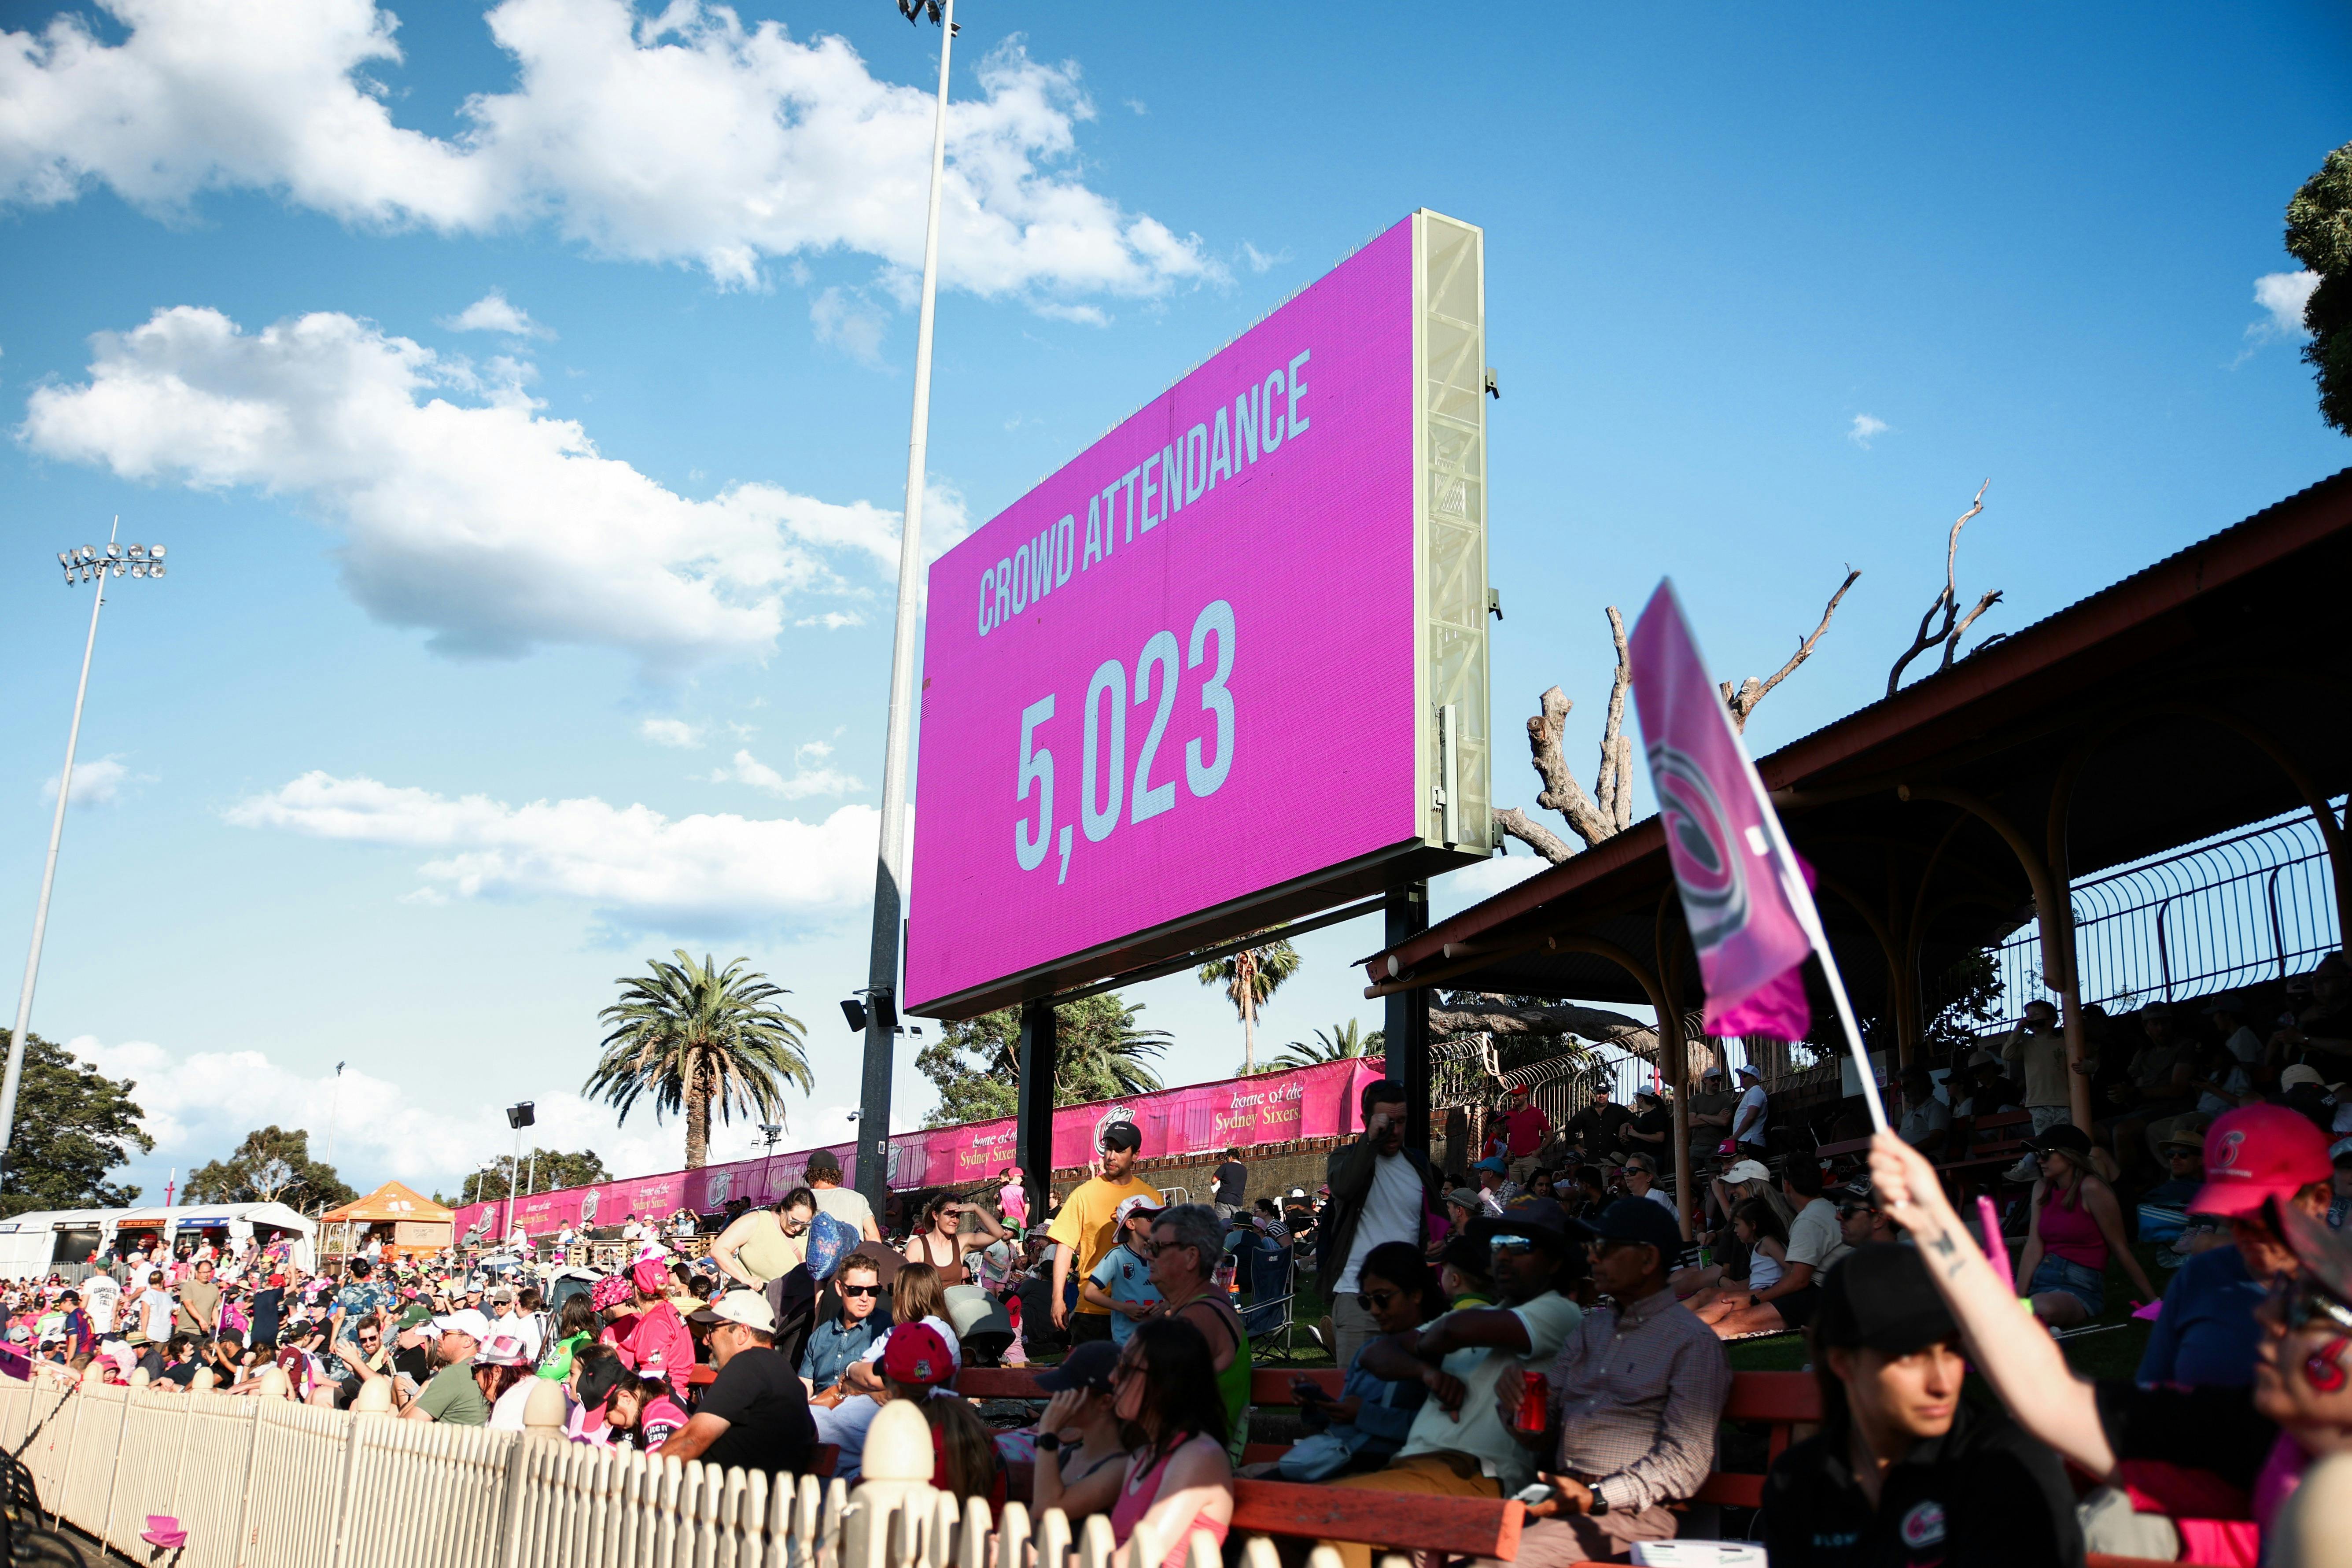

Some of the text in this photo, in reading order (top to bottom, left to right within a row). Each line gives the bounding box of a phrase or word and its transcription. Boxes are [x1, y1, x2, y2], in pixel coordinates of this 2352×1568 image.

[978, 347, 1310, 637] CROWD ATTENDANCE
[1015, 600, 1235, 885] 5,023
[1230, 1082, 1303, 1109] home of the
[1215, 1105, 1301, 1134] Sydney Sixers.
[972, 1134, 996, 1148] home
[998, 1128, 1011, 1144] of
[960, 1149, 990, 1170] Sydney
[640, 1183, 670, 1197] home of the
[632, 1198, 650, 1214] Sydney
[94, 1287, 116, 1295] DARKNESS
[646, 1424, 660, 1436] Lite
[649, 1432, 667, 1443] Easy
